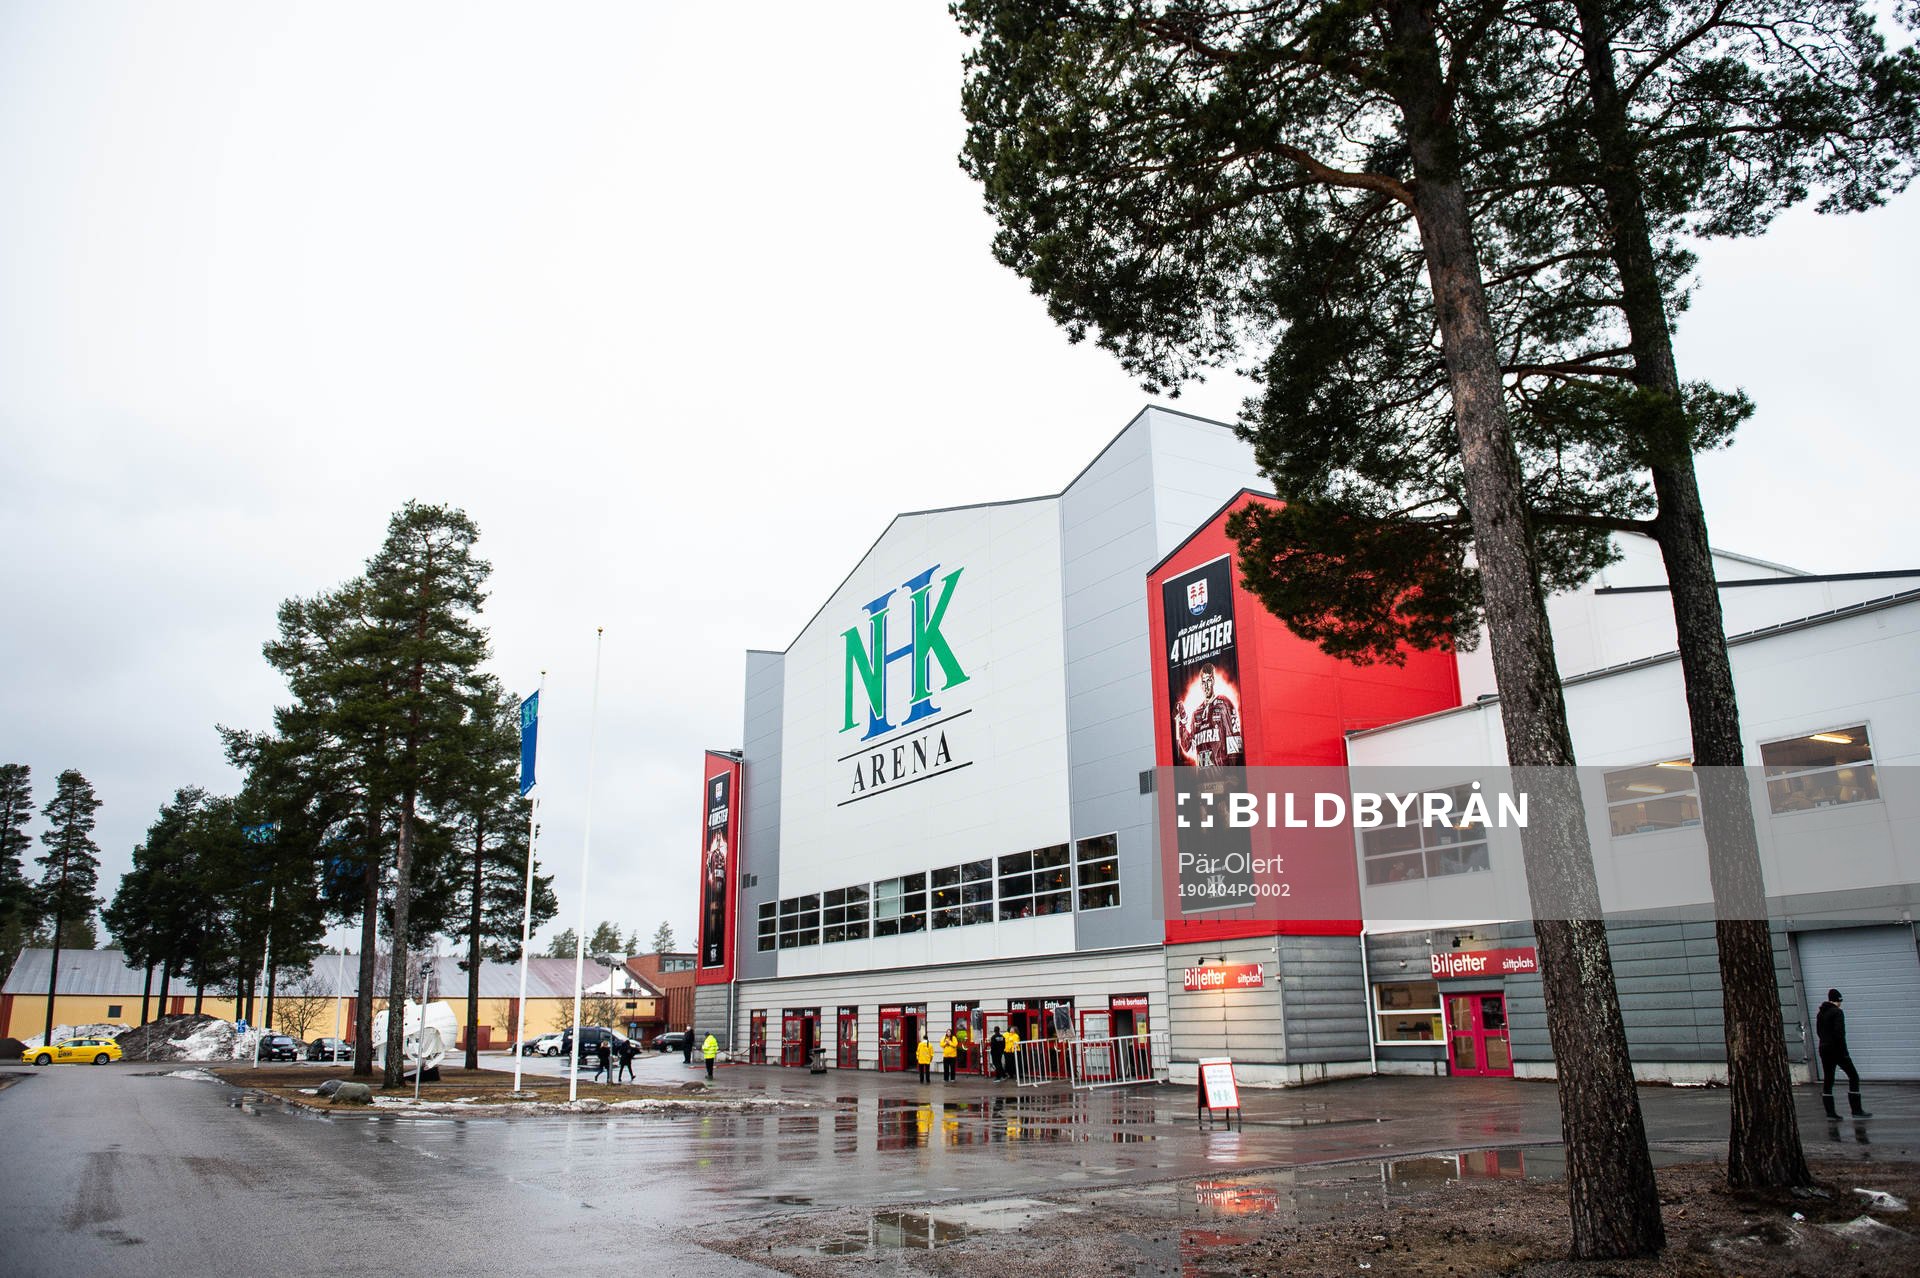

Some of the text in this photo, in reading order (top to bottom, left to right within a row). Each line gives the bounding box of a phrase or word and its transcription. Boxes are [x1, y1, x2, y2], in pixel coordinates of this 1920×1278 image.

[839, 564, 970, 742] NHK
[1171, 619, 1233, 662] 4 VINSTER
[851, 730, 952, 794] ARENA
[1184, 968, 1261, 990] Biljetter sittplats
[1431, 953, 1534, 977] Biljetter sittplats
